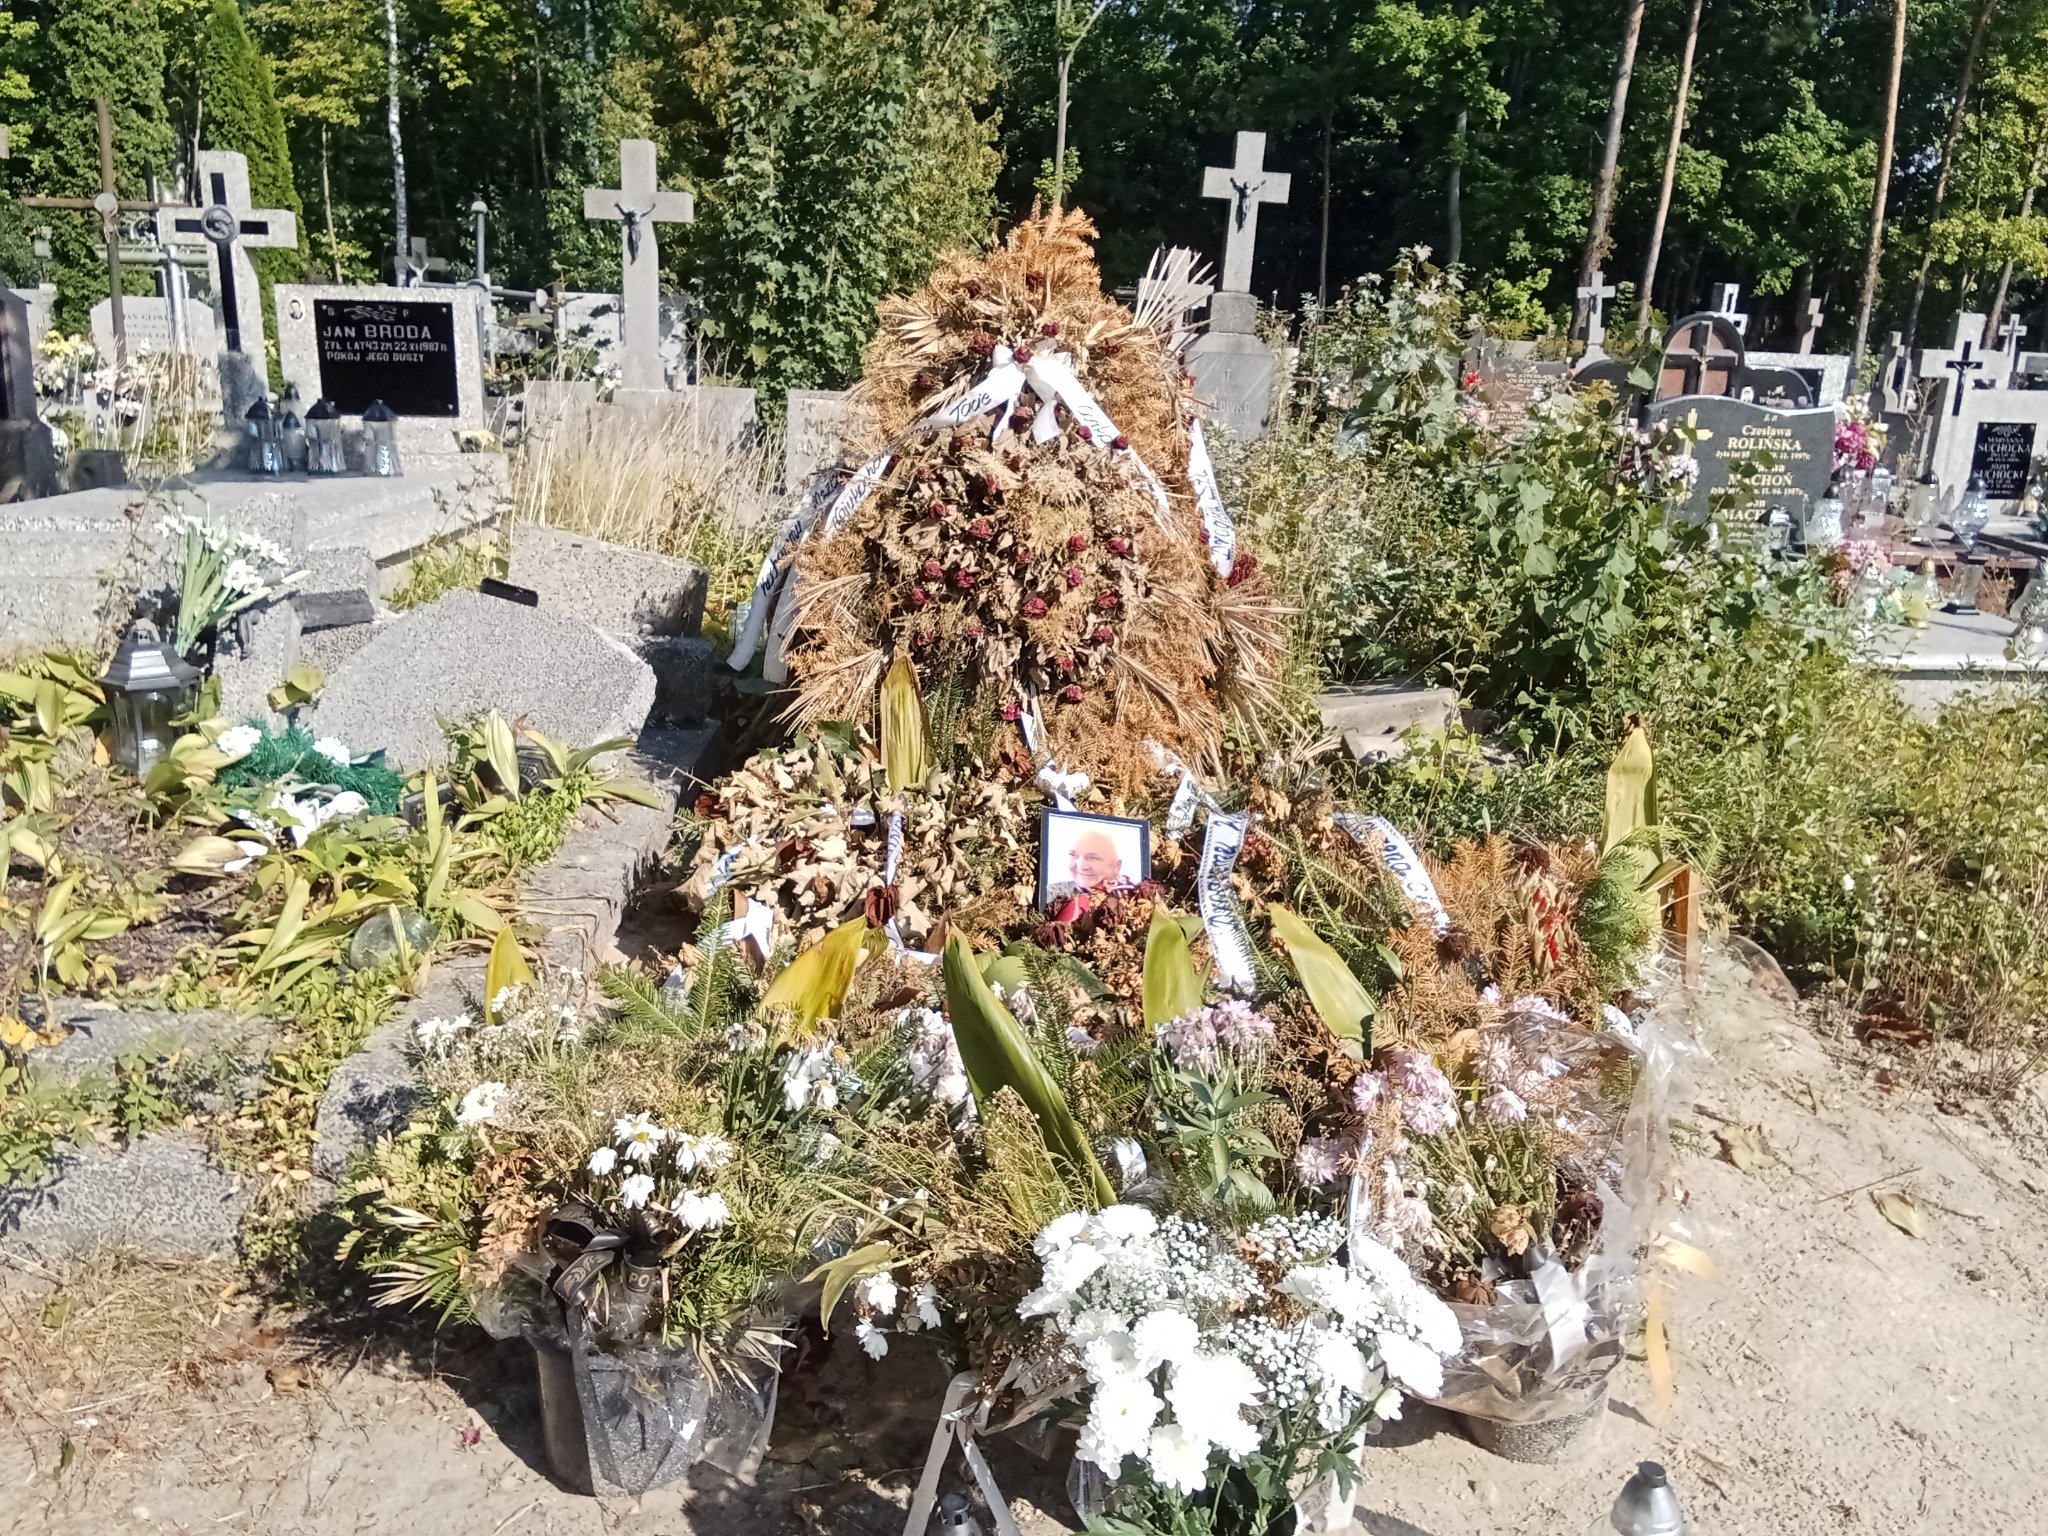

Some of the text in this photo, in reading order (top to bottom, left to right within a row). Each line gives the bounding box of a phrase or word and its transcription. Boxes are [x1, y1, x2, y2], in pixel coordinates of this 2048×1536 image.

[323, 324, 432, 339] JAN BRODA
[346, 341, 365, 351] LAT
[394, 341, 408, 351] 22
[366, 352, 390, 362] JEGO
[392, 352, 425, 362] DUSZY
[949, 391, 993, 424] Tacie
[1742, 424, 1792, 437] Czesława
[1727, 436, 1802, 451] ROLIŃSKA
[1978, 443, 2030, 453] SUCHOCKA
[1973, 469, 2024, 480] SUCHOCKI
[1720, 508, 1768, 521] MACH
